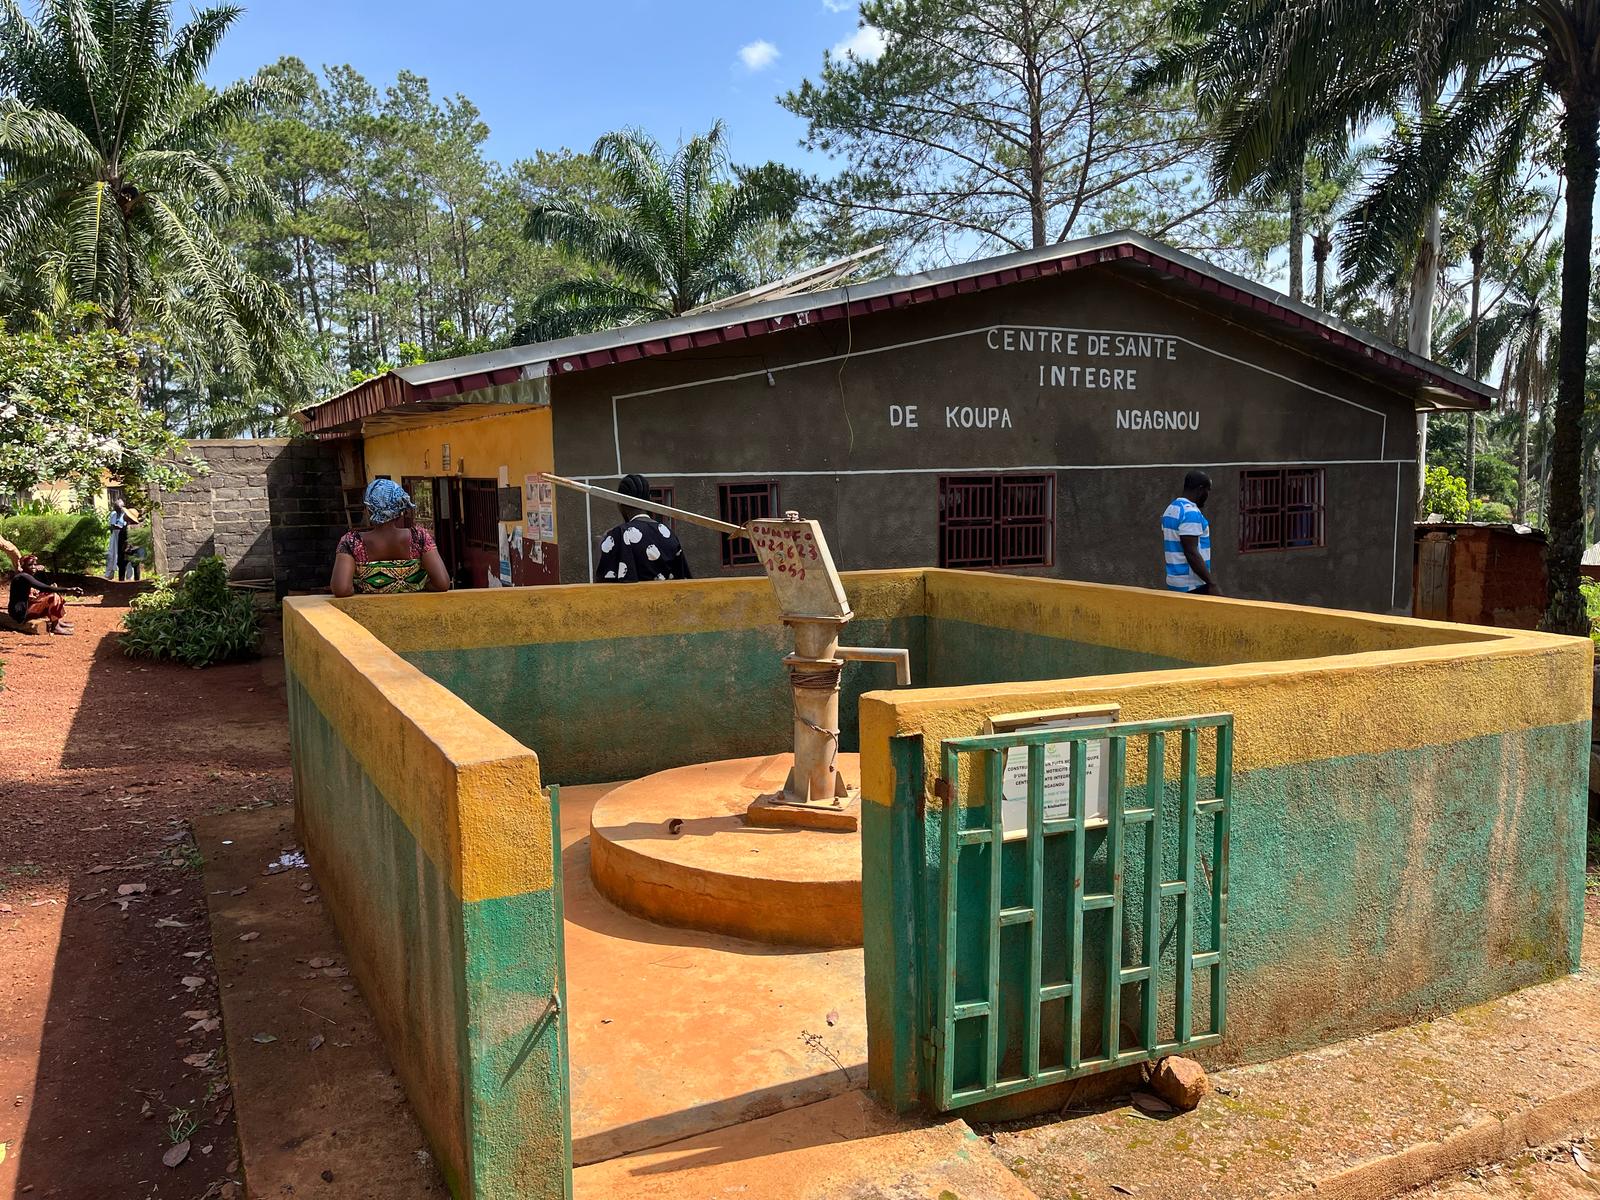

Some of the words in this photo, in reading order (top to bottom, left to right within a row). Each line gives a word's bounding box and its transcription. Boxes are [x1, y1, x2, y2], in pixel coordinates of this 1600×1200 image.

[987, 329, 1079, 355] CENTRE
[1088, 335, 1110, 356] DE
[1115, 336, 1177, 360] SANTE
[1039, 365, 1137, 390] INTEGRE
[889, 405, 918, 428] DE
[945, 405, 1012, 429] KOUPA
[1116, 409, 1200, 431] NGAGNOU
